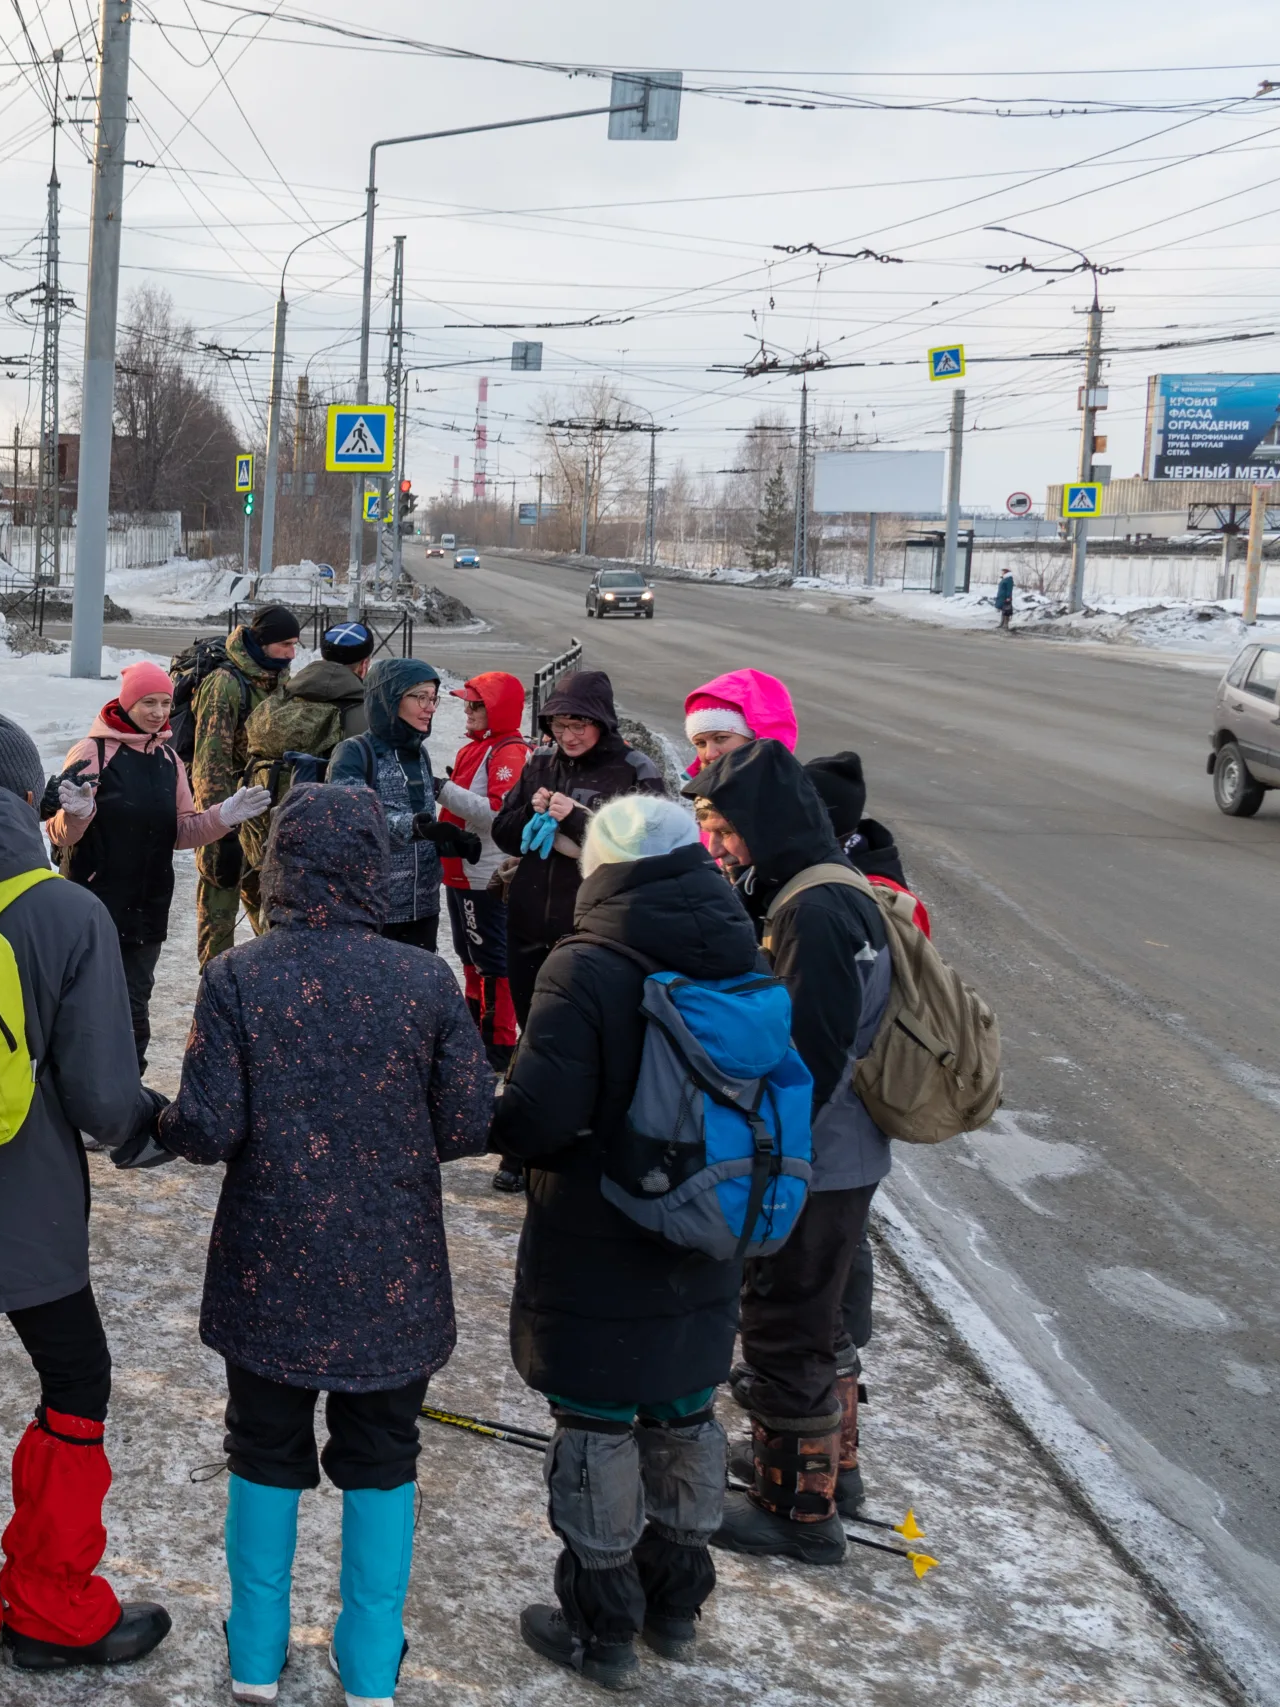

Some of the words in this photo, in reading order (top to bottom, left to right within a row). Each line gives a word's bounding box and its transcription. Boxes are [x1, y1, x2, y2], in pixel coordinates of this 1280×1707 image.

[1169, 397, 1217, 406] КРОВЛЯ
[1169, 408, 1212, 419] ФАСАД
[1168, 420, 1250, 431] ОГРАЖДЕНИЯ
[1164, 463, 1230, 479] ЧЕРНЫЙ
[463, 898, 477, 929] asics
